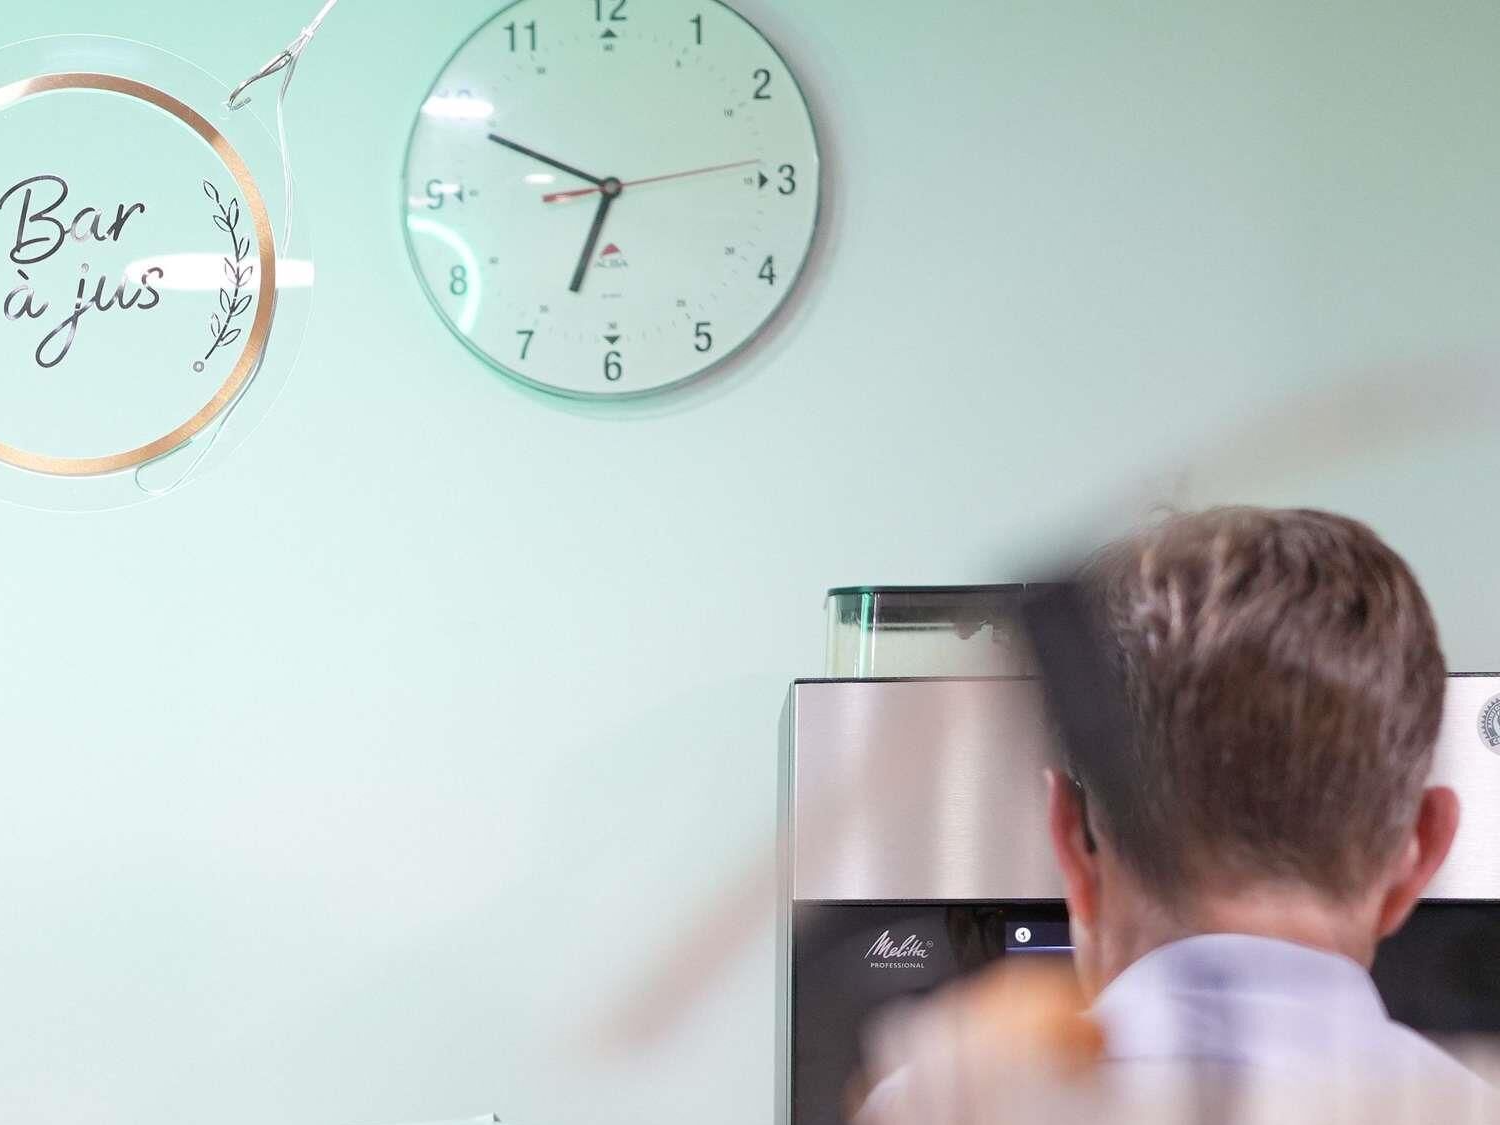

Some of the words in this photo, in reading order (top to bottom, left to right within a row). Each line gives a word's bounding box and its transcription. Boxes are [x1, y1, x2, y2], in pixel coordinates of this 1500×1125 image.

[503, 22, 538, 52] 11
[689, 15, 703, 45] 1
[752, 68, 772, 100] 2
[777, 164, 797, 196] 3
[449, 264, 468, 296] 8
[757, 254, 777, 286] 4
[2, 268, 50, 322] à
[33, 262, 165, 369] jus
[516, 329, 534, 360] 7
[694, 322, 713, 352] 5
[603, 351, 622, 382] 6
[864, 930, 930, 960] Melitta
[870, 961, 925, 969] PROFESSIONAL
